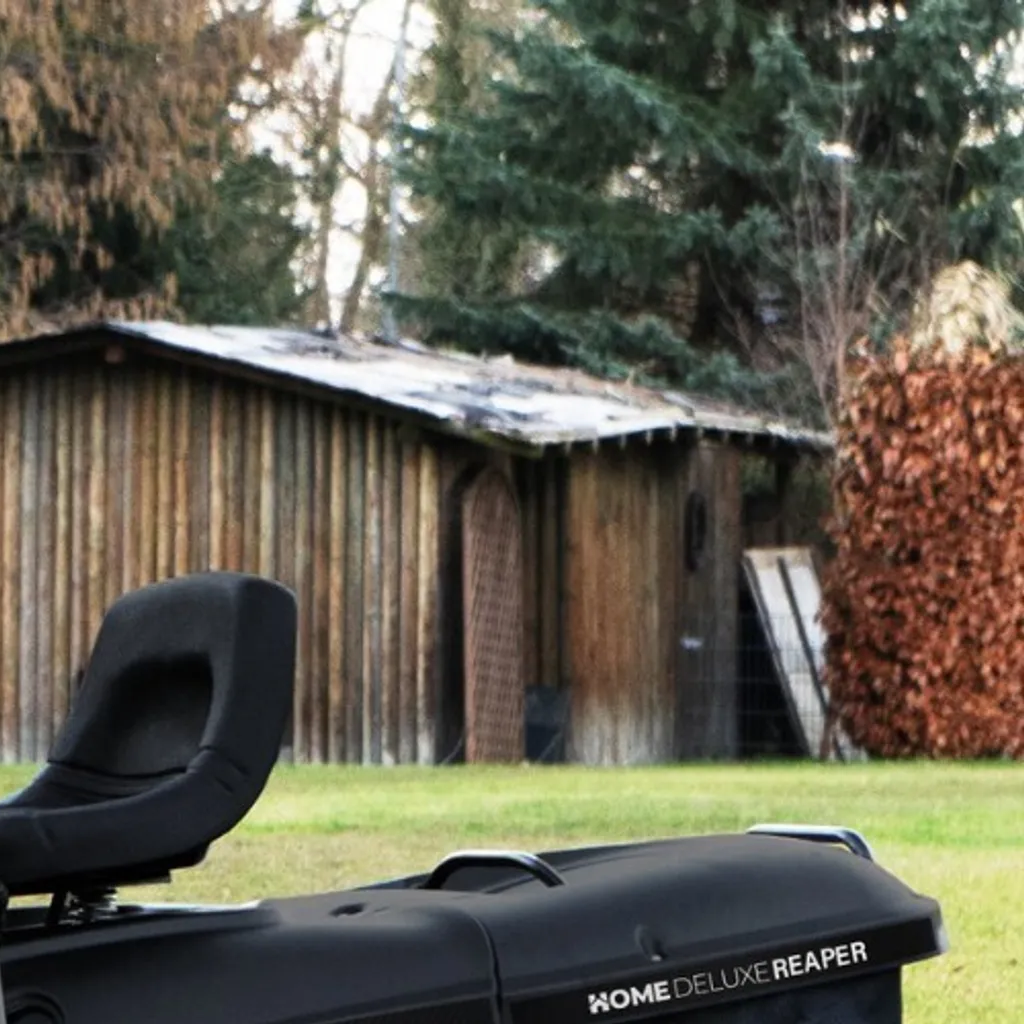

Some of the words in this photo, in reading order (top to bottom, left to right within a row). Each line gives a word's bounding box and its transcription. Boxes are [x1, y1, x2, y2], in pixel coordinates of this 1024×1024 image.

[587, 980, 671, 1014] HOME
[672, 961, 771, 999] DELUXE
[771, 941, 868, 981] REAPER
